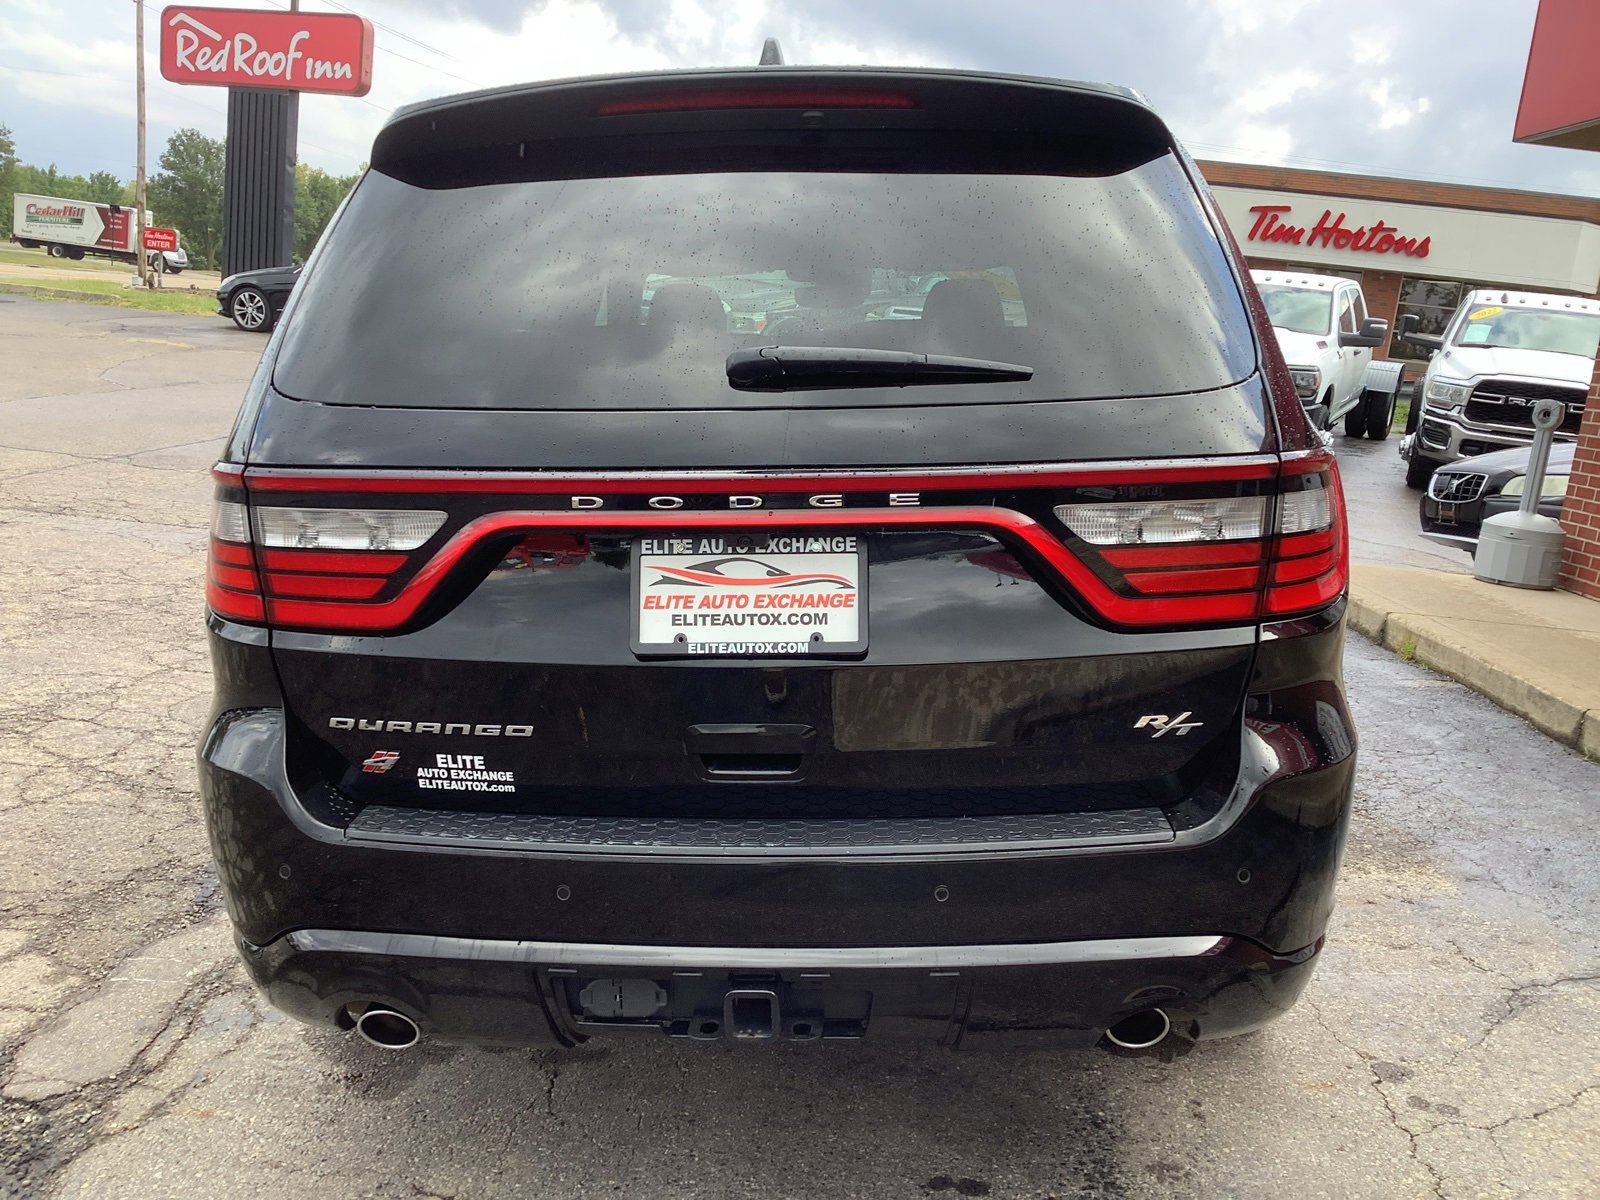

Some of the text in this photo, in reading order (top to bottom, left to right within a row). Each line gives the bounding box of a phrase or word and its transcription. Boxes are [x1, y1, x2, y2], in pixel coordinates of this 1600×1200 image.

[176, 28, 231, 72] Red
[234, 31, 310, 80] Roof
[1248, 205, 1431, 258] Tim Hortons
[147, 240, 170, 248] ENTER
[571, 493, 920, 509] DODGE
[641, 539, 693, 554] ELITE
[643, 594, 855, 610] ELITE AUTO EXCHANGE
[671, 613, 828, 626] ELITEAUTOX.COM
[687, 642, 809, 654] ELITEAUTOX.COM
[329, 717, 534, 737] DURANGO
[1133, 711, 1204, 738] R/T
[436, 754, 486, 769] ELITE
[417, 768, 514, 782] AUTO EXCHANGE
[418, 779, 515, 793] ELITEAUTOX.com
